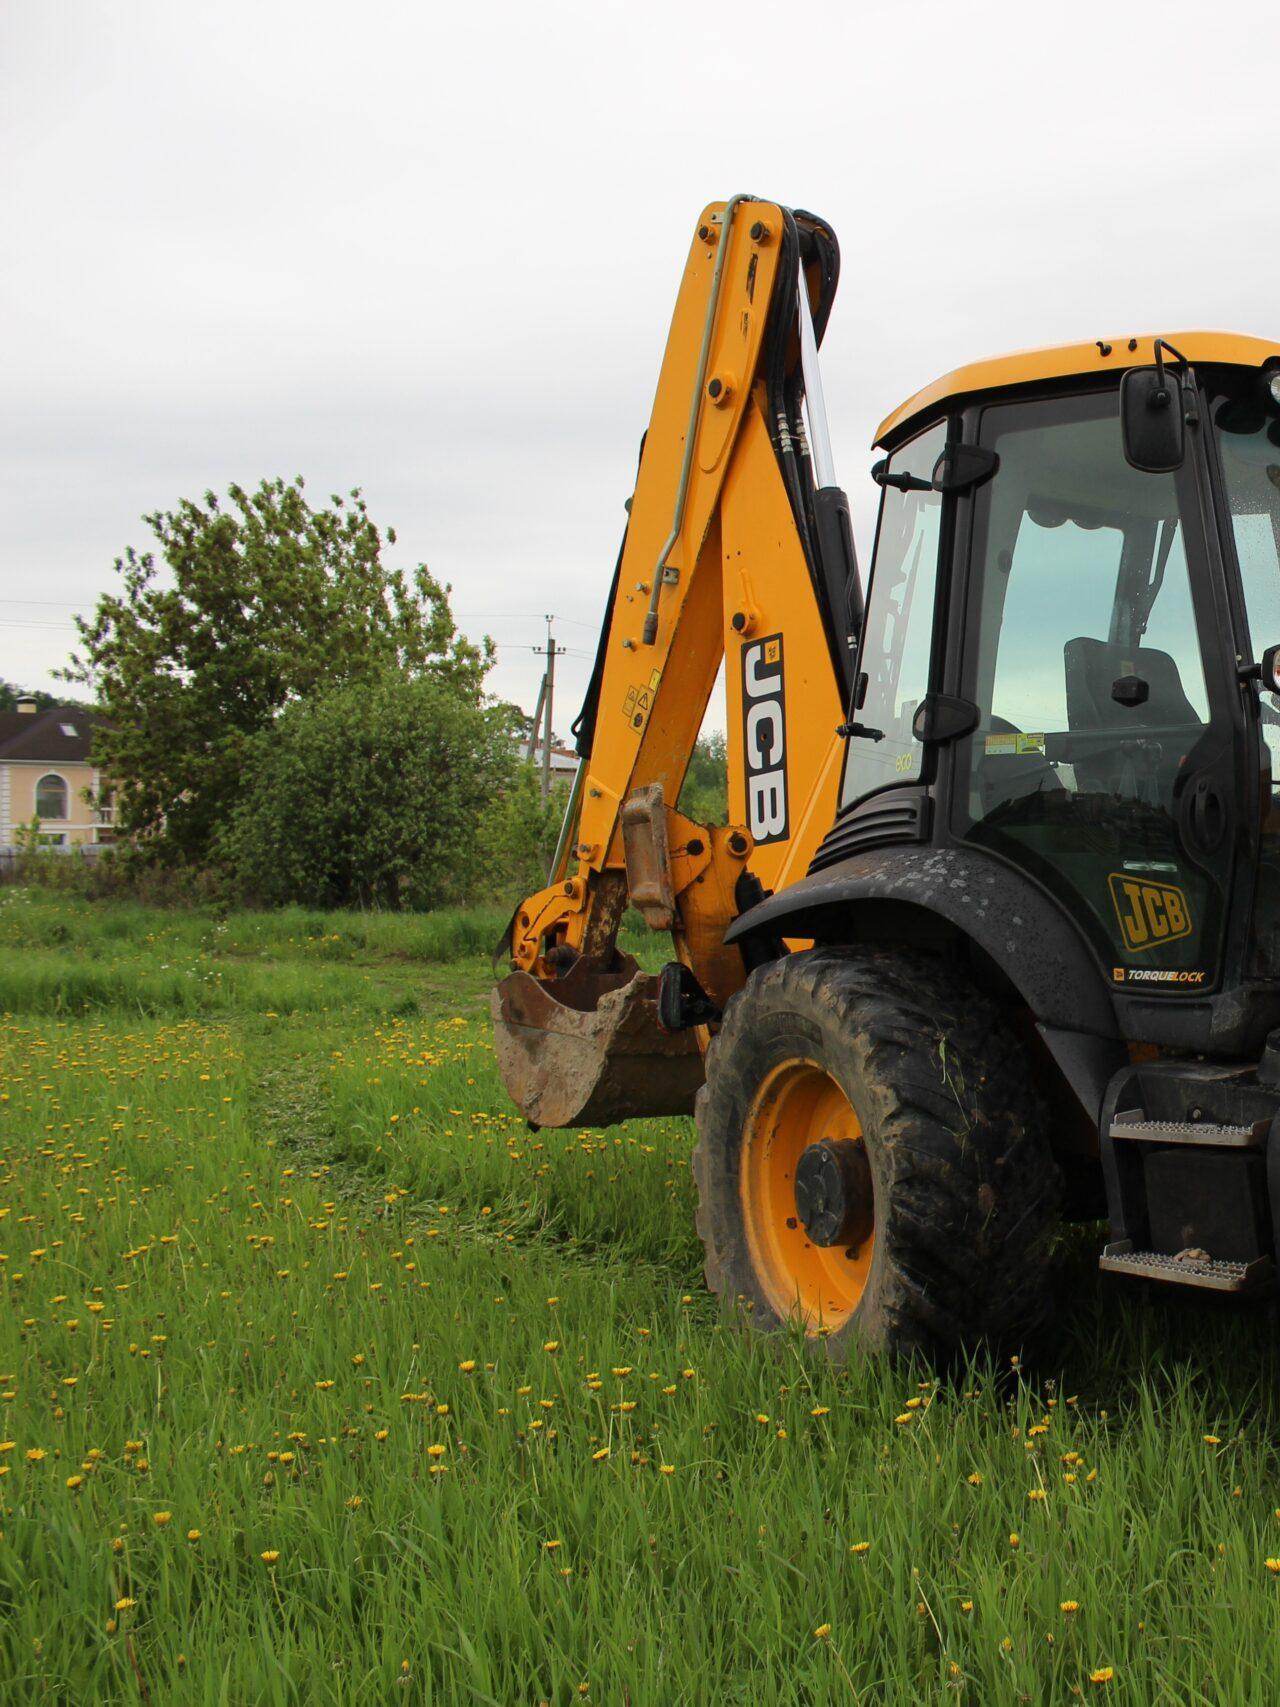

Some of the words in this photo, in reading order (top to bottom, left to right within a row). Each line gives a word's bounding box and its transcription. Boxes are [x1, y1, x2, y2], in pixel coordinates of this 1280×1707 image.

[744, 644, 787, 842] JCB
[895, 753, 912, 773] eco
[1122, 882, 1186, 944] JCB
[1128, 969, 1205, 983] TORQUELOCK
